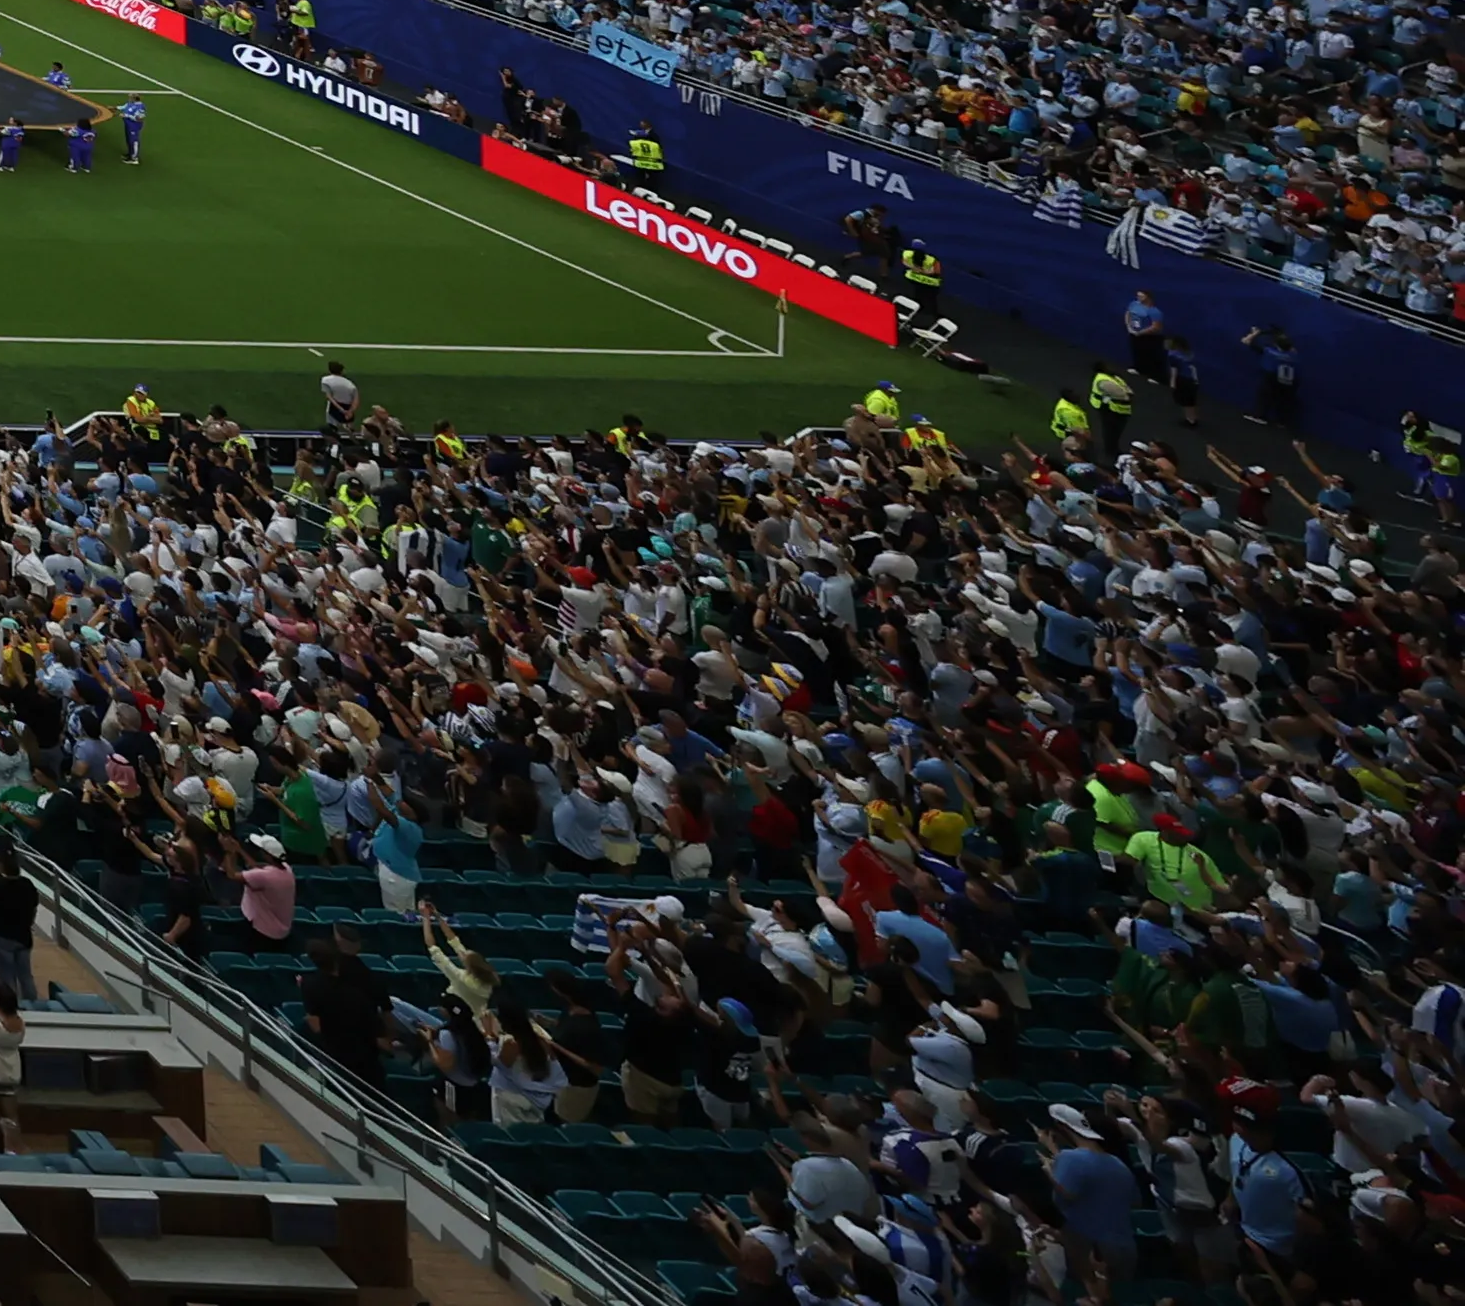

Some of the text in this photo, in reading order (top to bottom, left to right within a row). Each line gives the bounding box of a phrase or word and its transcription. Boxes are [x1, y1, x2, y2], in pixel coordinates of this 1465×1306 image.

[596, 35, 671, 78] etxe
[286, 62, 420, 135] HYUNDAI
[827, 150, 915, 201] FIFA
[586, 180, 758, 279] Lenovo
